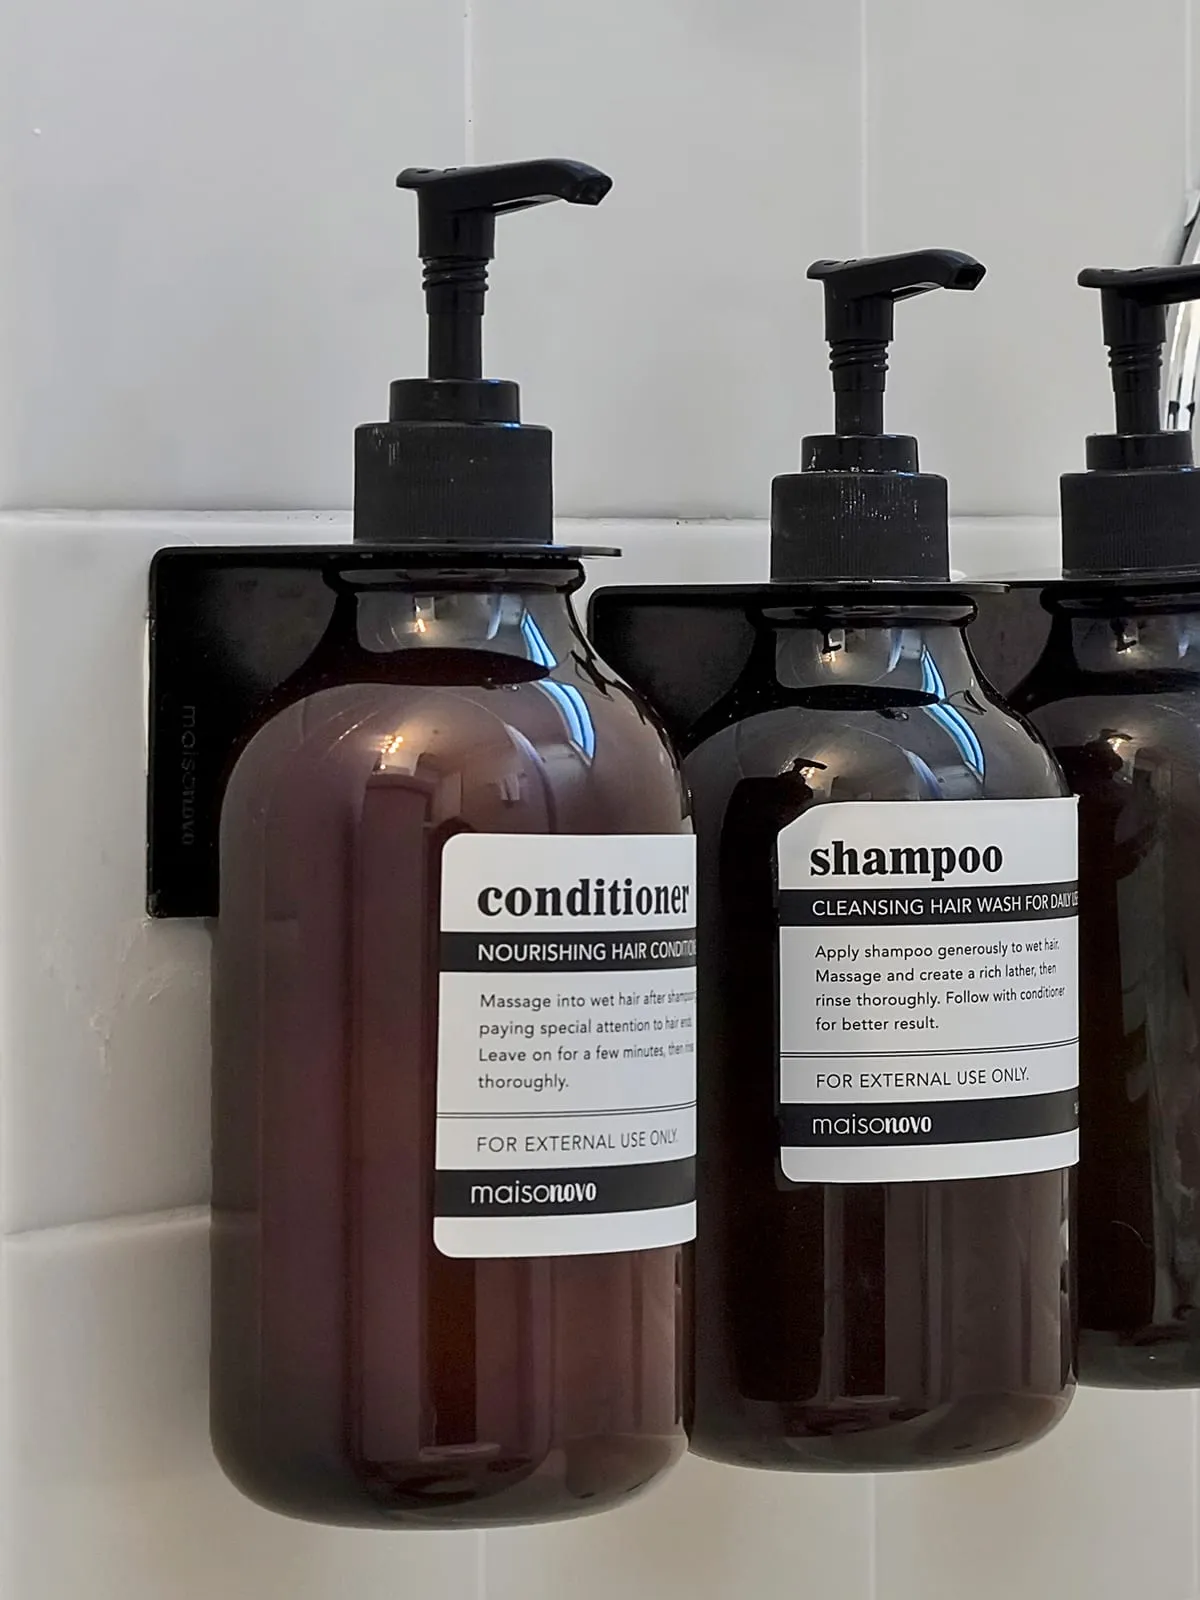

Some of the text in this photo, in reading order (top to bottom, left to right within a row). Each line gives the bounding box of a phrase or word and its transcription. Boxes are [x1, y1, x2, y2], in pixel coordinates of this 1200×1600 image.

[809, 840, 1004, 881] shampoo
[477, 877, 690, 917] conditioner
[811, 899, 925, 917] CLEANSING
[930, 897, 972, 915] HAIR
[976, 895, 1022, 914] WASH
[1025, 893, 1049, 911] FOR
[477, 943, 607, 962] NOURISHING
[612, 942, 647, 960] HAIR
[815, 937, 1061, 962] Apply shampoo generously to wet hair.
[815, 962, 1057, 986] Massage and create a rich lather, then
[480, 993, 551, 1011] Massage
[557, 993, 586, 1008] into
[590, 994, 615, 1007] wet
[618, 992, 640, 1006] hair
[643, 989, 666, 1005] after
[815, 985, 1067, 1009] rinse thoroughly. Follow with conditioner
[479, 1020, 535, 1039] paying
[540, 1018, 592, 1038] special
[596, 1018, 650, 1034] attention
[653, 1019, 664, 1031] to
[815, 1015, 940, 1032] for better result.
[479, 1047, 526, 1062] Leave
[532, 1050, 552, 1062] on
[557, 1046, 578, 1062] for
[583, 1050, 591, 1060] a
[596, 1045, 619, 1060] few
[623, 1043, 667, 1060] minutes,
[478, 1073, 570, 1092] thoroughly.
[816, 1065, 1030, 1089] FOR EXTERNAL USE ONLY.
[811, 1113, 933, 1136] maisonovo
[476, 1127, 679, 1153] FOR EXTERNAL USE ONLY.
[470, 1179, 598, 1204] maisonovo
